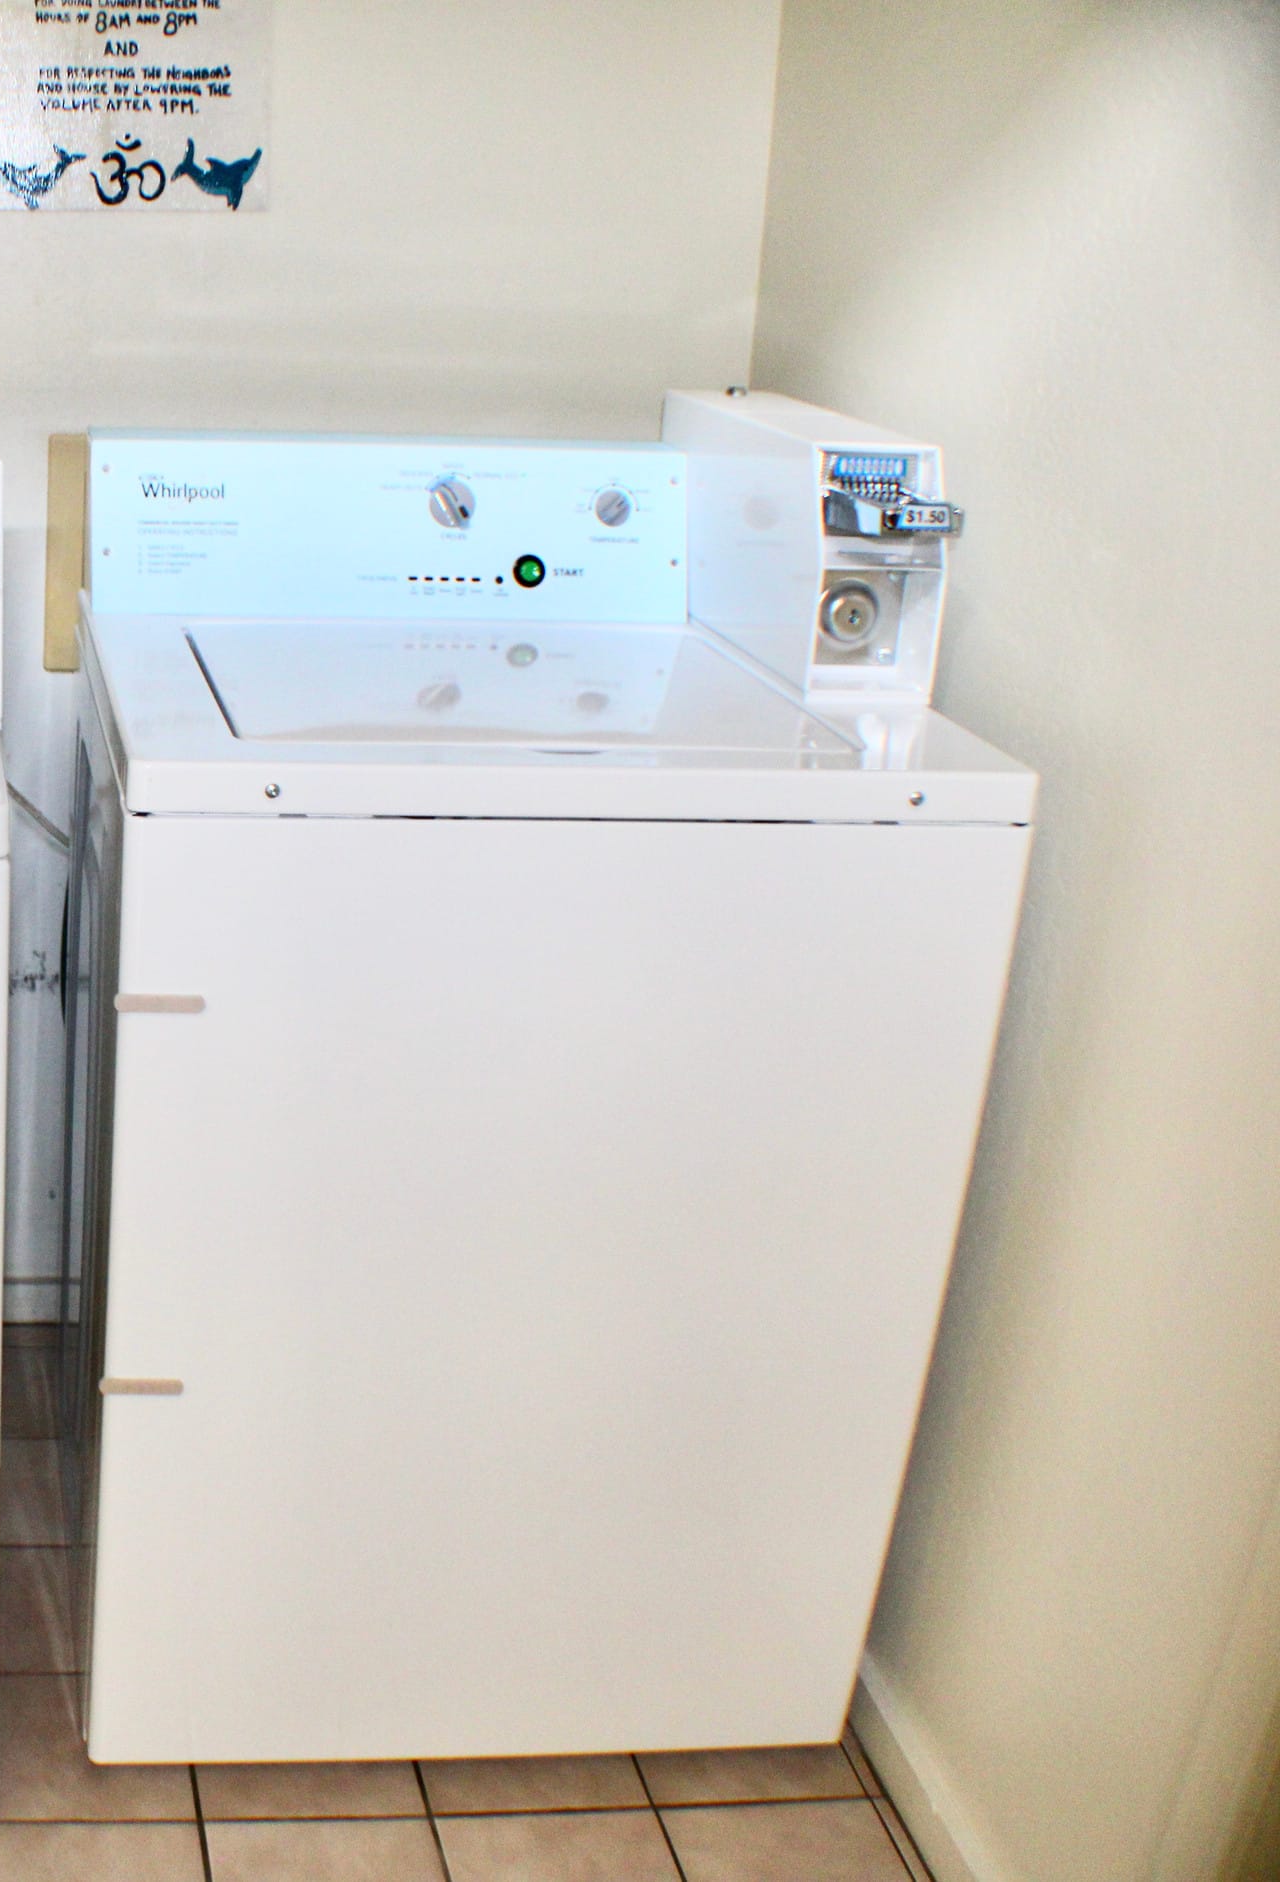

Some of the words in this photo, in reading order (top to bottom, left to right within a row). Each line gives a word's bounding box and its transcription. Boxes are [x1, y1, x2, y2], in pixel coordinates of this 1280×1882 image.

[35, 10, 71, 24] HOURS
[76, 11, 90, 24] OF
[95, 10, 131, 34] 8AM
[136, 13, 161, 25] AND
[163, 10, 198, 37] 8PM
[104, 40, 139, 56] AND
[39, 66, 61, 80] FOR
[141, 66, 162, 80] THE
[37, 82, 63, 95] AND
[113, 82, 129, 97] BY
[206, 82, 232, 97] THE
[39, 98, 101, 112] VOLUME
[106, 98, 152, 112] AFTER
[141, 482, 225, 503] Whirlpool
[906, 509, 946, 524] $1.50
[552, 568, 585, 577] START
